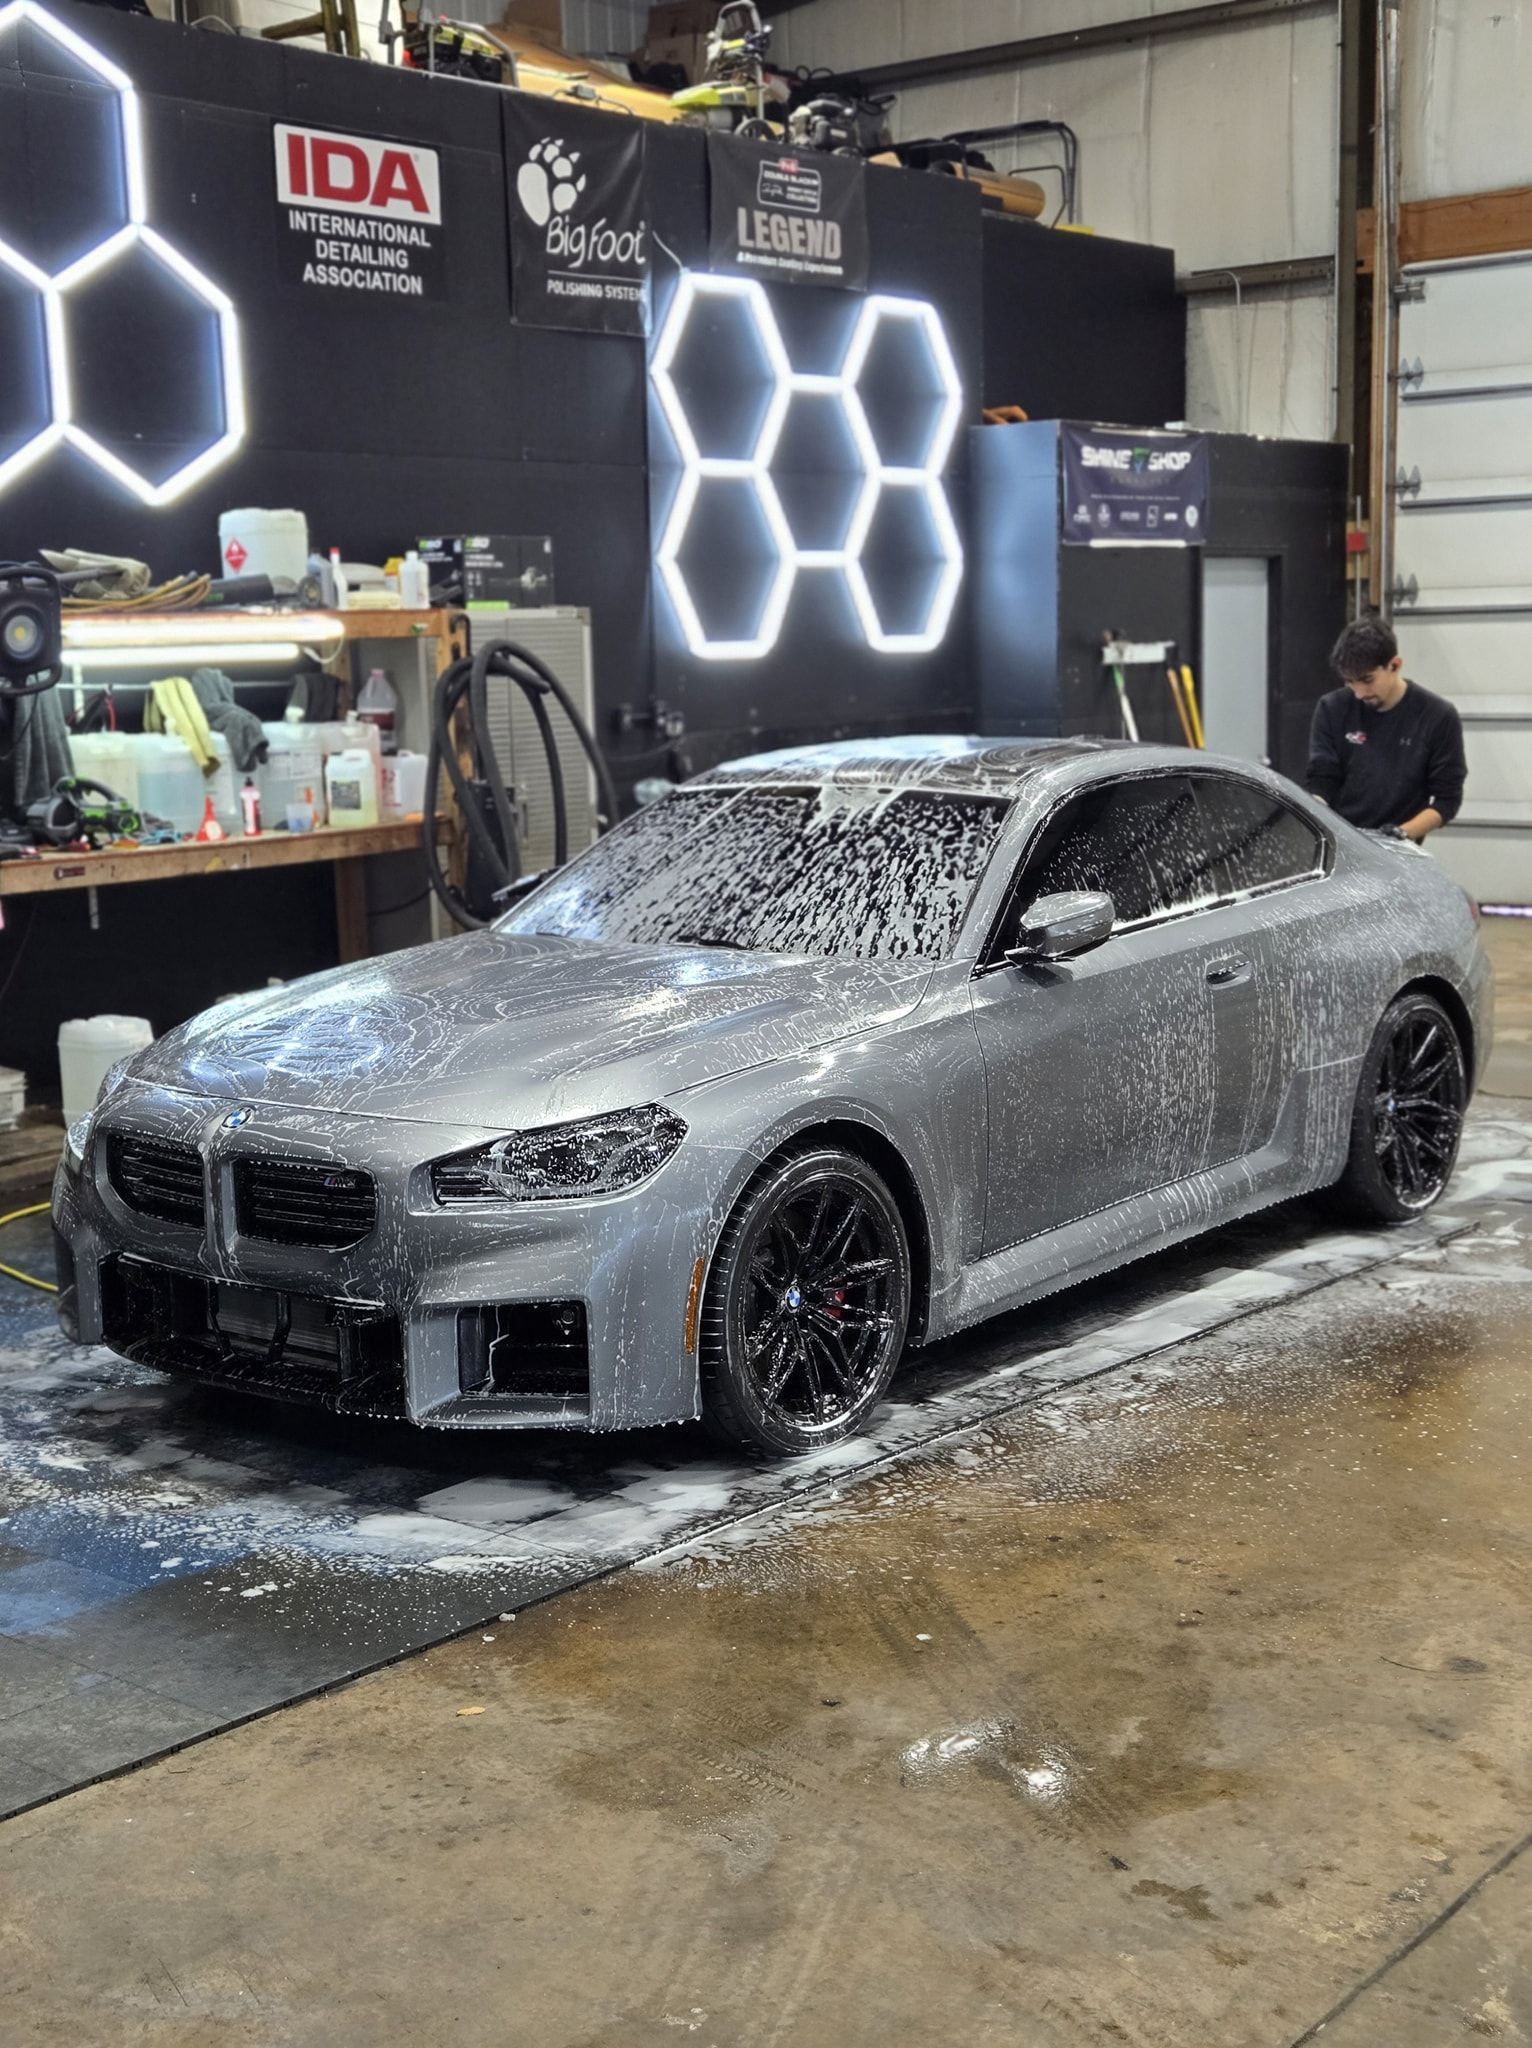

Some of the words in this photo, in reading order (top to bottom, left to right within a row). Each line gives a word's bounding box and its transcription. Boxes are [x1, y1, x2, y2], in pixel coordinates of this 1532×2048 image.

[287, 133, 430, 214] IDA
[289, 209, 431, 247] INTERNATIONAL
[738, 206, 841, 260] LEGEND
[316, 238, 409, 269] DETAILING
[303, 262, 423, 295] ASSOCIATION
[547, 279, 602, 298] POLISHING
[1148, 451, 1191, 471] SHOP
